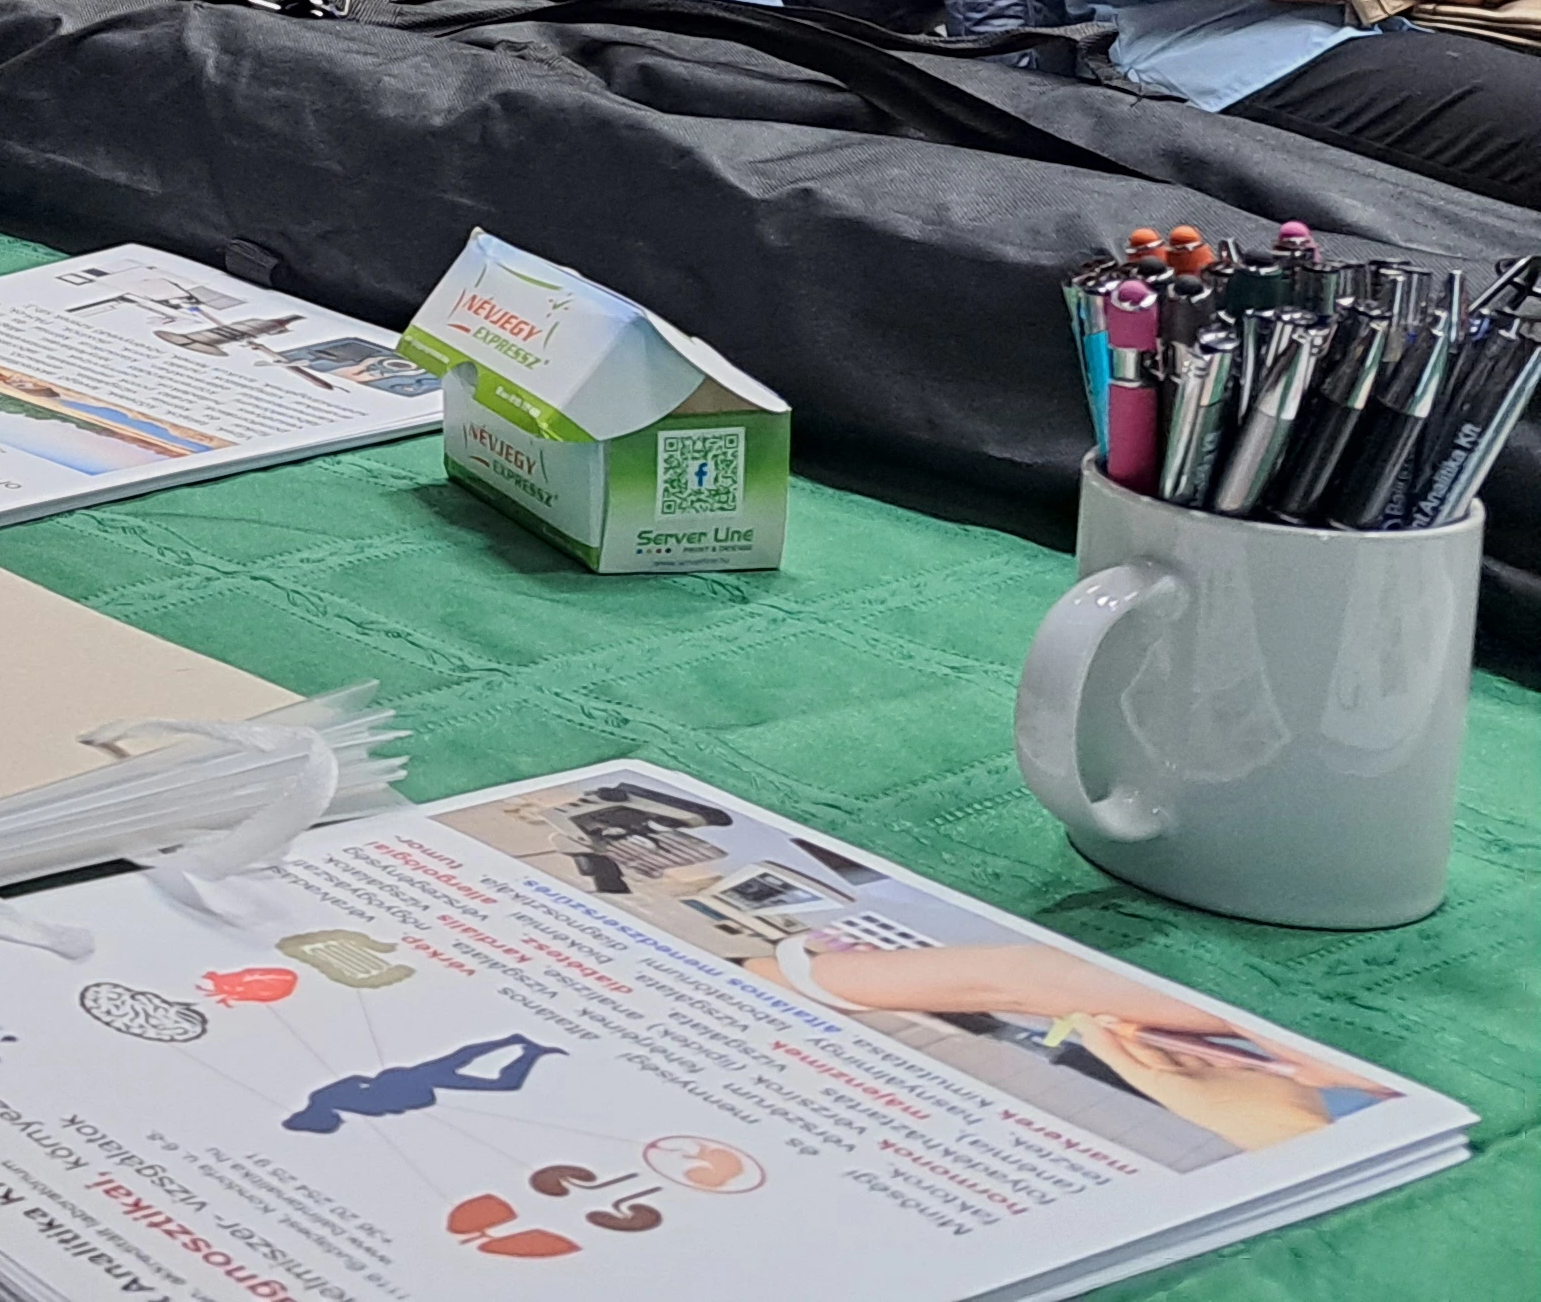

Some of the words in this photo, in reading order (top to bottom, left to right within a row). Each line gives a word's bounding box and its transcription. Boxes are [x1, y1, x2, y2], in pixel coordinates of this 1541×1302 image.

[462, 294, 542, 342] NÉVJEGY
[472, 326, 542, 370] EXPRESSZ
[468, 423, 536, 475] NÉVJEGY
[492, 460, 553, 508] EXPRESSZ
[636, 529, 707, 546] Server
[713, 526, 754, 543] Line
[342, 846, 488, 921] vérszegénység
[436, 914, 532, 963] kardiális
[508, 911, 613, 964] biokémiai
[497, 987, 600, 1039] általános
[728, 978, 841, 1032] általános
[722, 1082, 855, 1152] vérszérum
[1001, 1109, 1137, 1174] markerek
[61, 1114, 207, 1211] vizsgálatok
[784, 1137, 820, 1155] és
[821, 1087, 1055, 1204] folyadékháztartás
[878, 1138, 1028, 1214] hormonok
[23, 1207, 154, 1291] Analitika
[85, 1171, 294, 1302] gnosztikai,
[214, 1215, 354, 1302] elmiszer-
